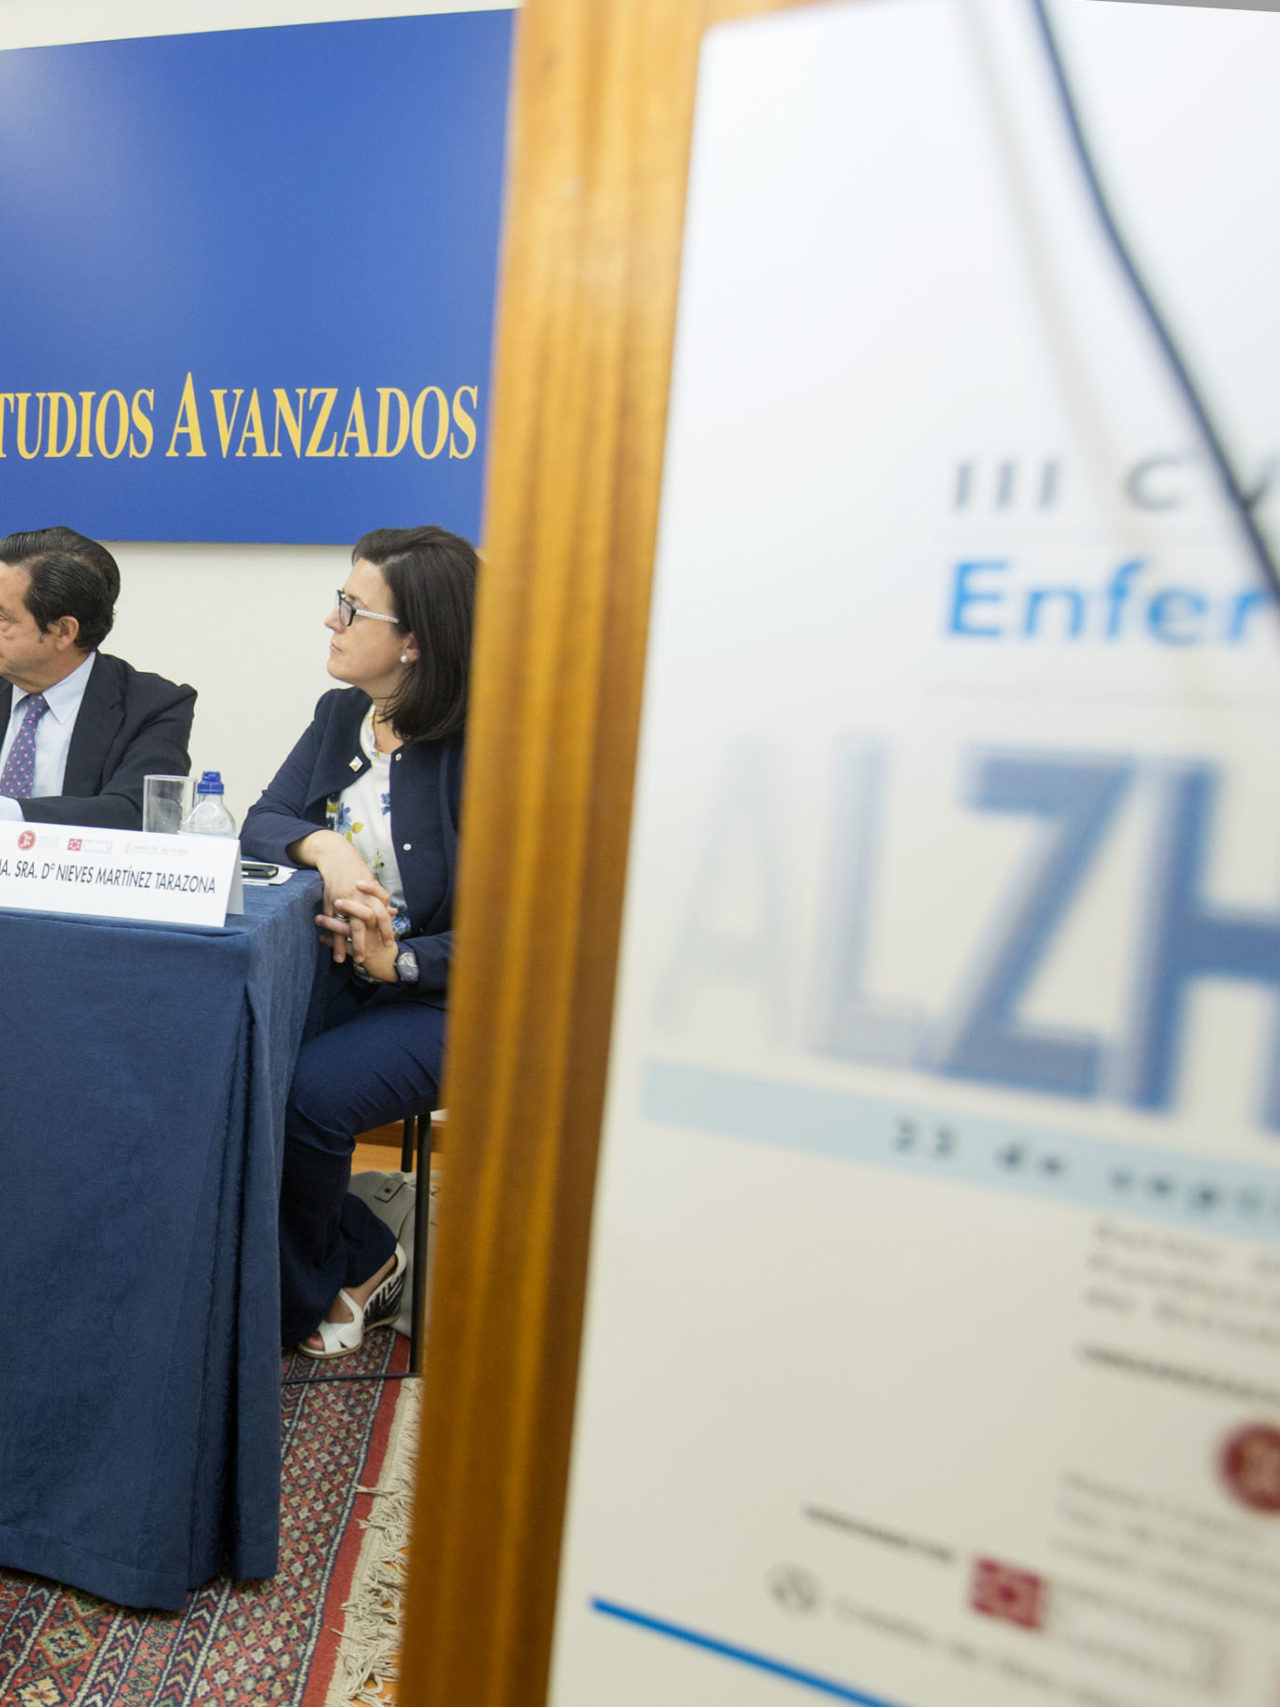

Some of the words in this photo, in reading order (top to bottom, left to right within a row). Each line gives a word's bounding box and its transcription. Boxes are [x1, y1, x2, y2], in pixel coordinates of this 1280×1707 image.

[165, 371, 479, 460] AVANZADOS
[14, 860, 38, 879] SRA.
[55, 863, 94, 884] NIEVES
[95, 865, 153, 889] MARTÍNEZ
[154, 872, 216, 894] TARAZONA
